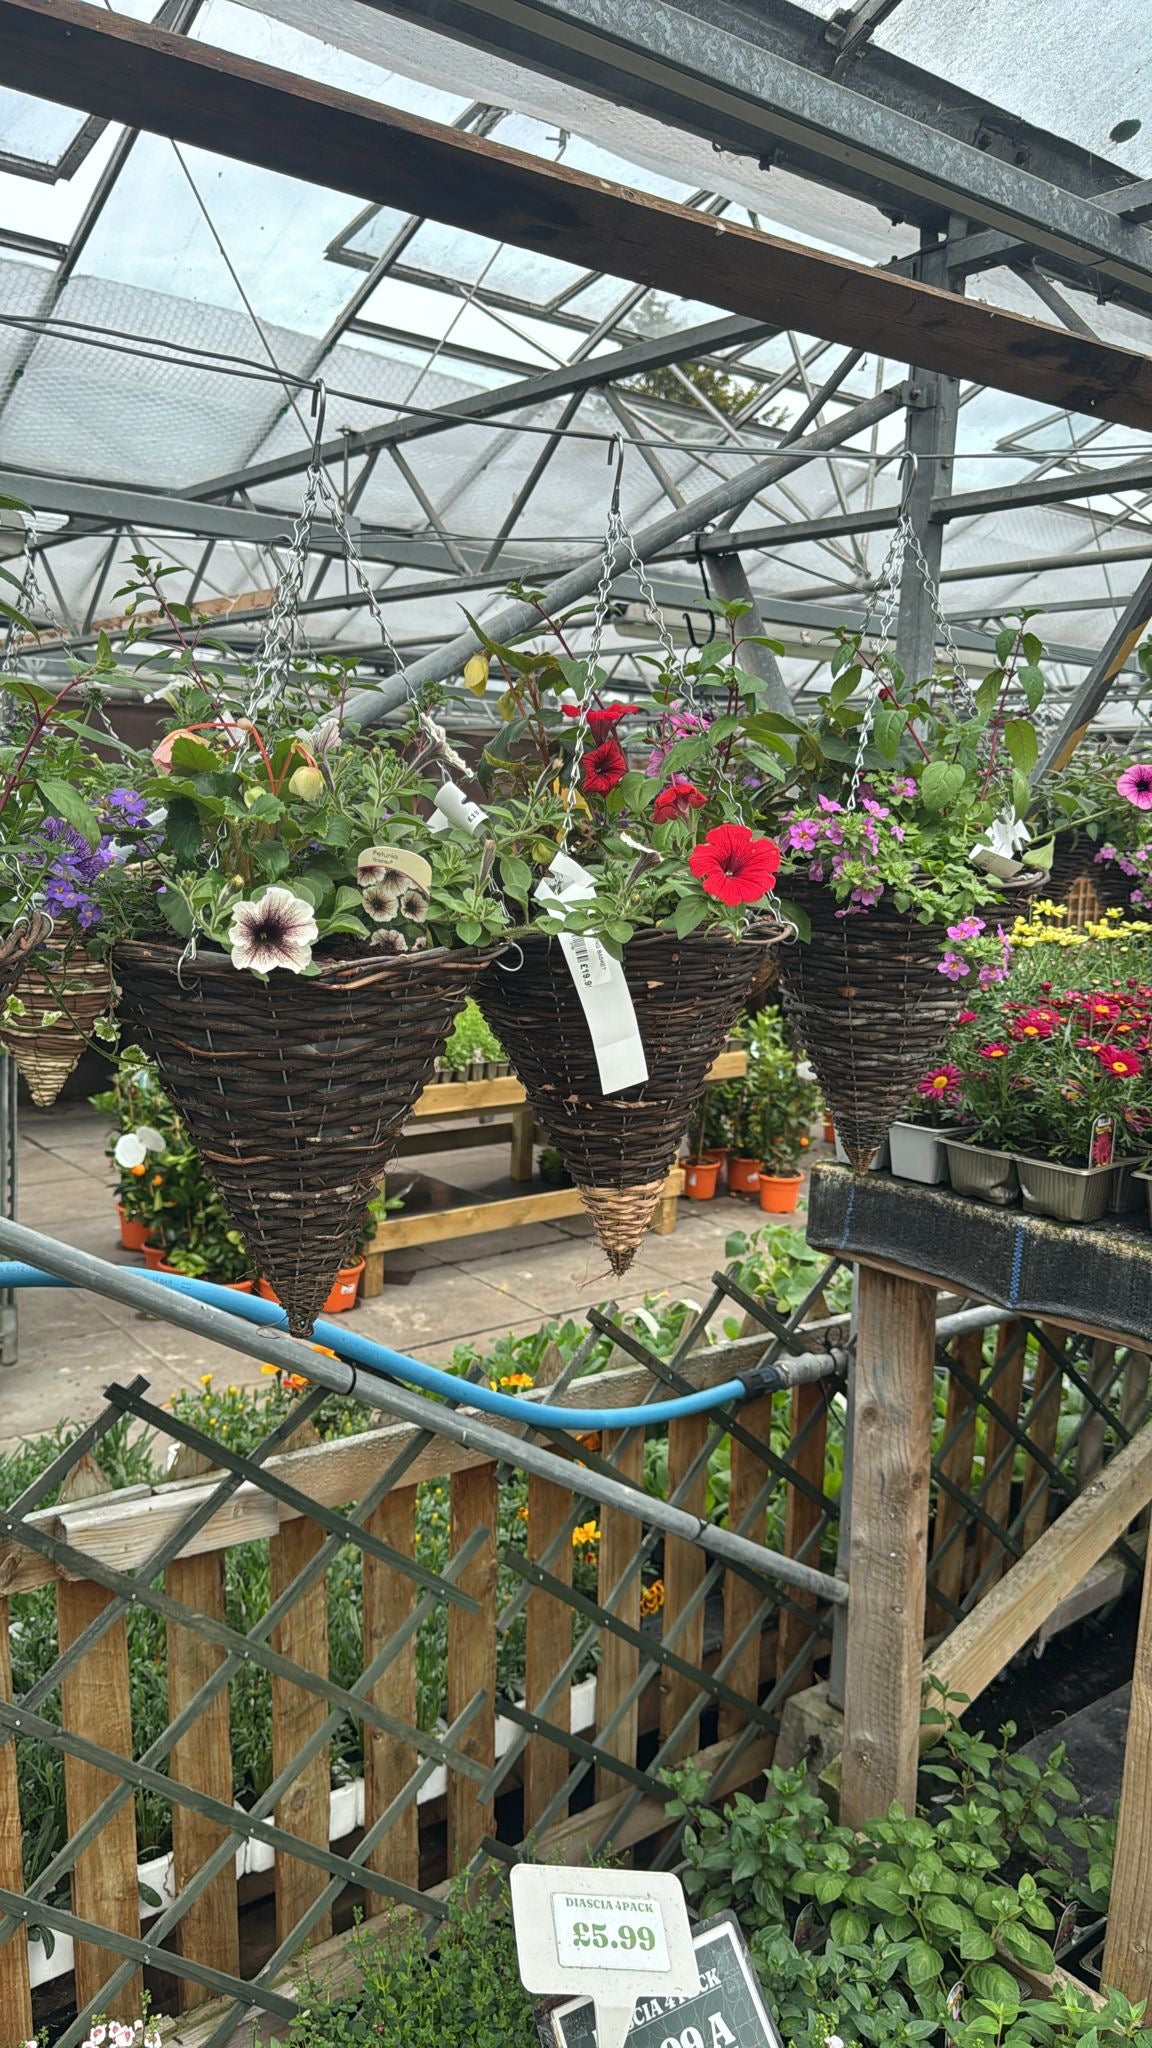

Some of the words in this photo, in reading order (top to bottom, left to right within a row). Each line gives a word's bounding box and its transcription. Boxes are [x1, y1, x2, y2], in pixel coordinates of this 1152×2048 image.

[372, 850, 399, 860] Petunia
[580, 963, 593, 988] £19.9
[565, 1897, 614, 1910] DIASCIA
[615, 1900, 654, 1913] 4PACK
[572, 1921, 656, 1952] £5.99
[664, 1967, 722, 2010] 4CK
